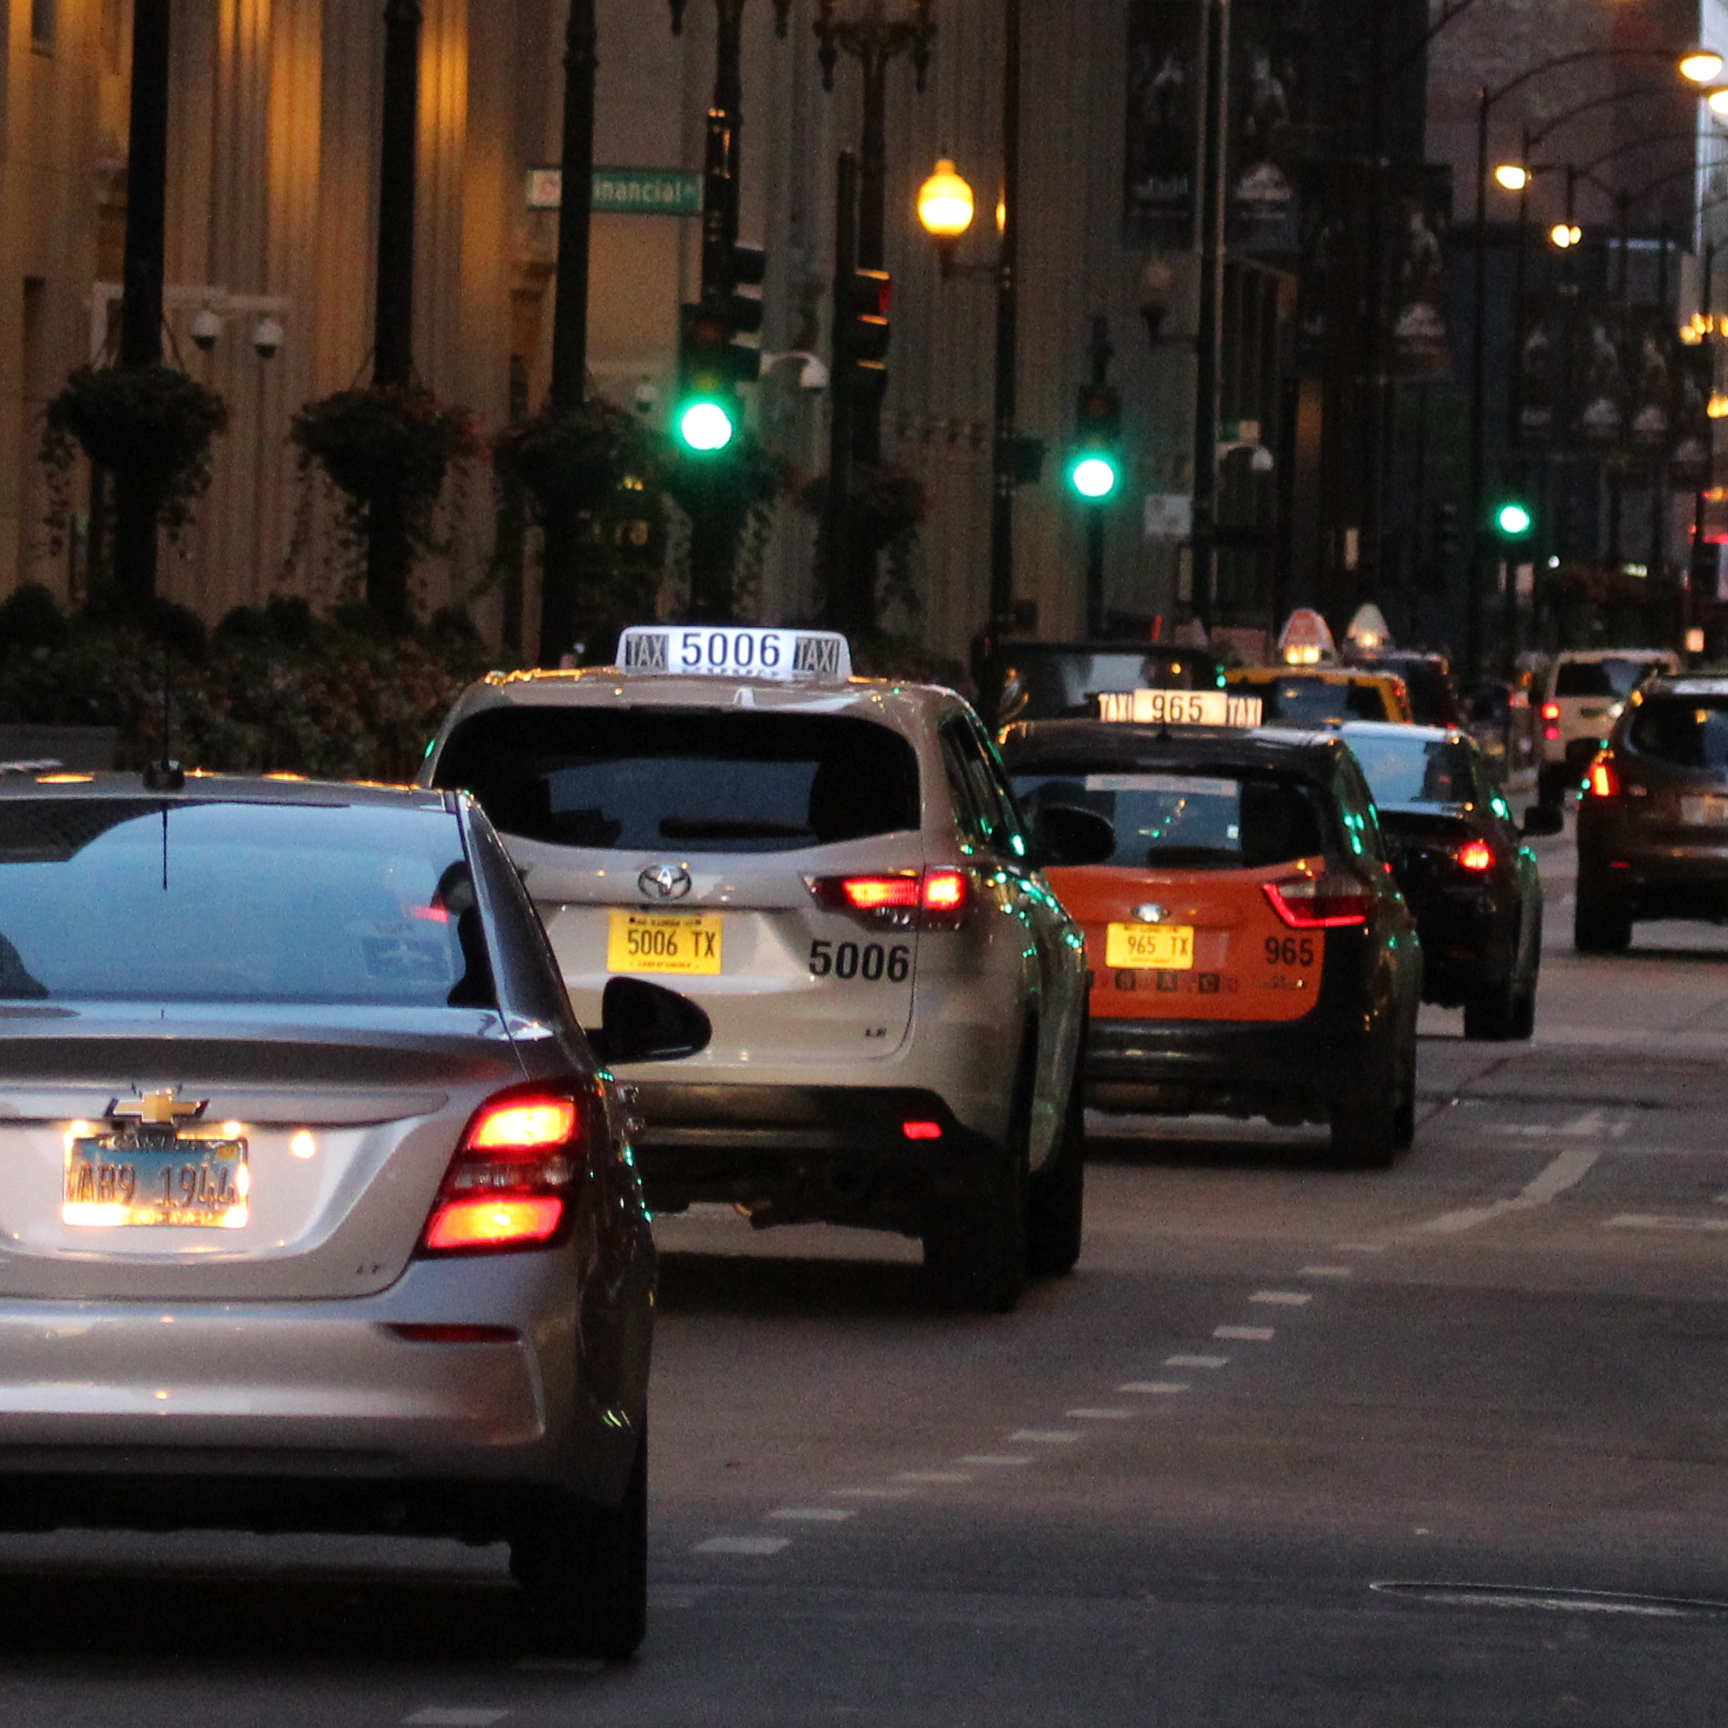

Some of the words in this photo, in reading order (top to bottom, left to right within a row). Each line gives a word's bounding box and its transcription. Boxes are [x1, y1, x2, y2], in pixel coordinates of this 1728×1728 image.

[593, 180, 682, 203] inancial
[681, 632, 781, 668] 5006
[794, 638, 840, 672] TAXI
[1098, 693, 1134, 723] TAXI
[1152, 694, 1204, 722] 965
[1228, 697, 1263, 728] TAXI
[627, 929, 678, 957] 5006
[692, 930, 716, 958] TX
[1127, 934, 1156, 956] 965
[1171, 936, 1189, 957] TX
[1264, 936, 1314, 967] 965
[809, 938, 910, 983] 5006
[155, 1162, 234, 1209] 1944
